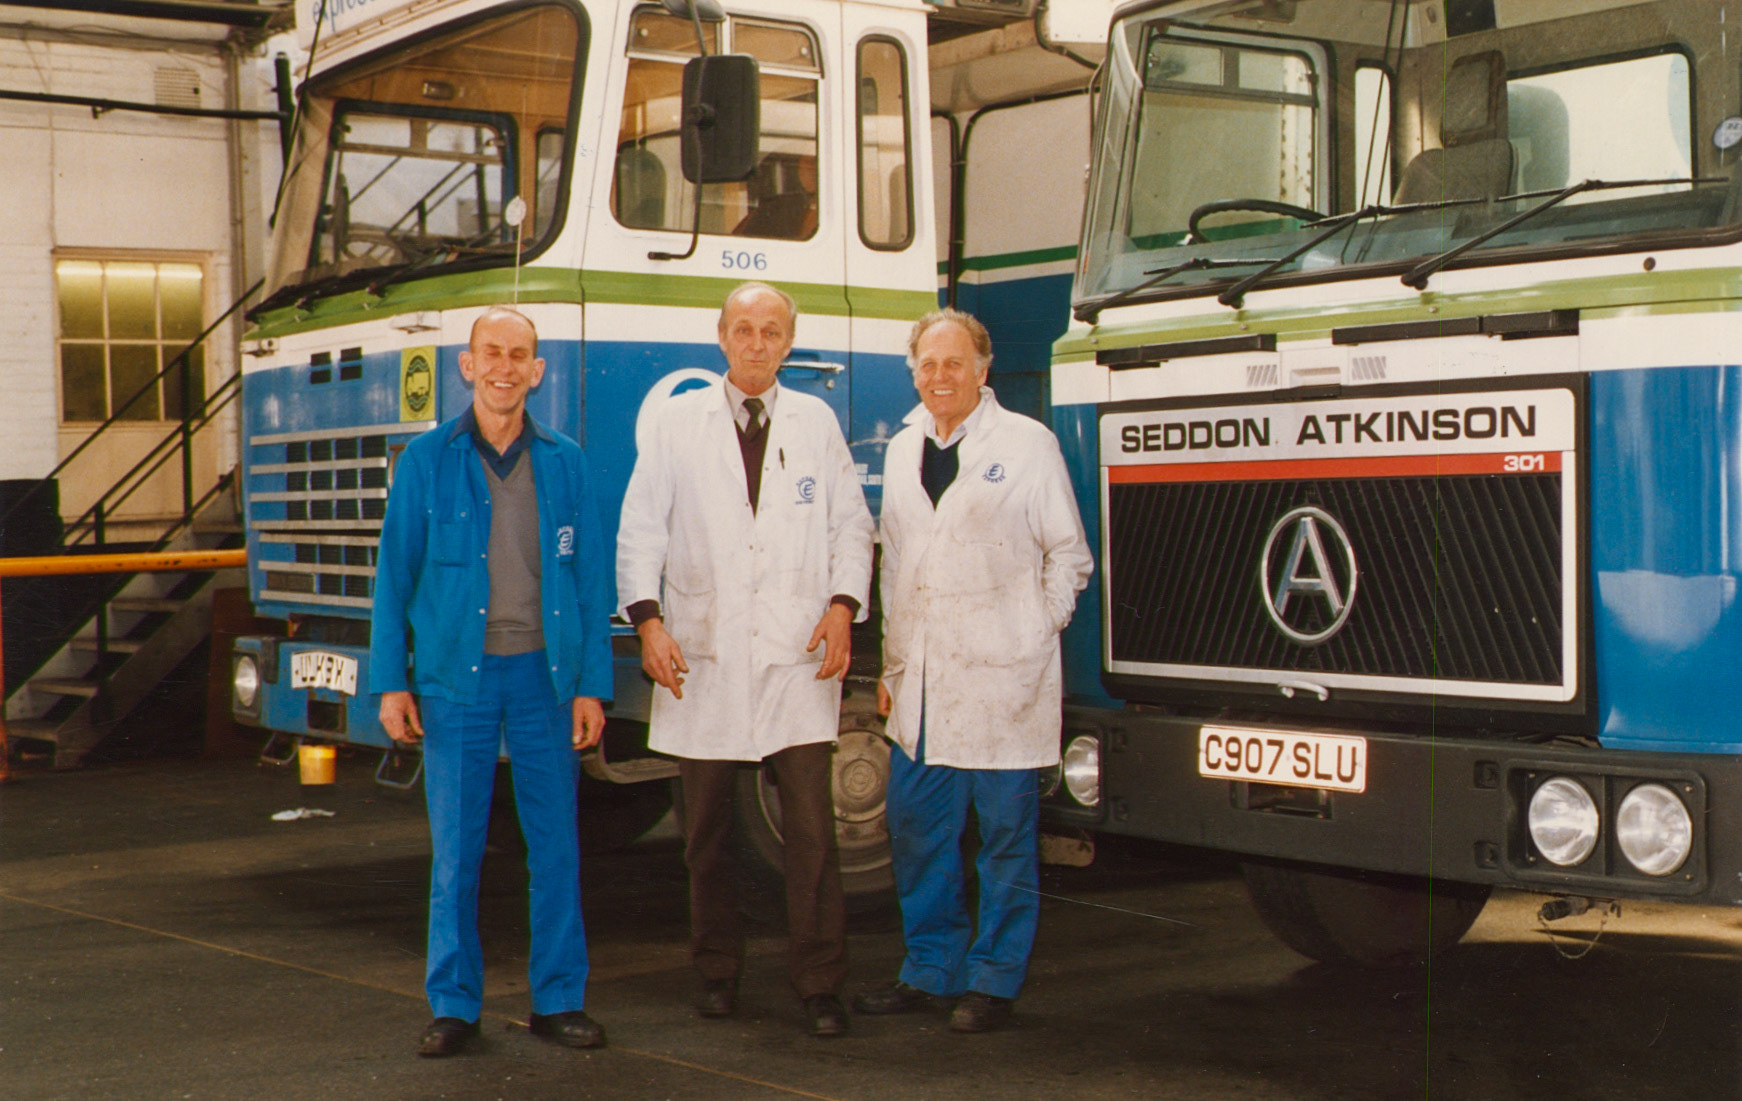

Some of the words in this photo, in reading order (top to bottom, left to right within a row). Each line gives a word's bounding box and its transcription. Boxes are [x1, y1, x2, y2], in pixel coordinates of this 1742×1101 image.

[721, 250, 767, 271] 506
[1121, 417, 1271, 454] SEDDON
[1296, 405, 1536, 446] ATKINSON
[1503, 455, 1545, 473] 301
[1205, 734, 1285, 775] C907
[1292, 741, 1357, 783] SLU
